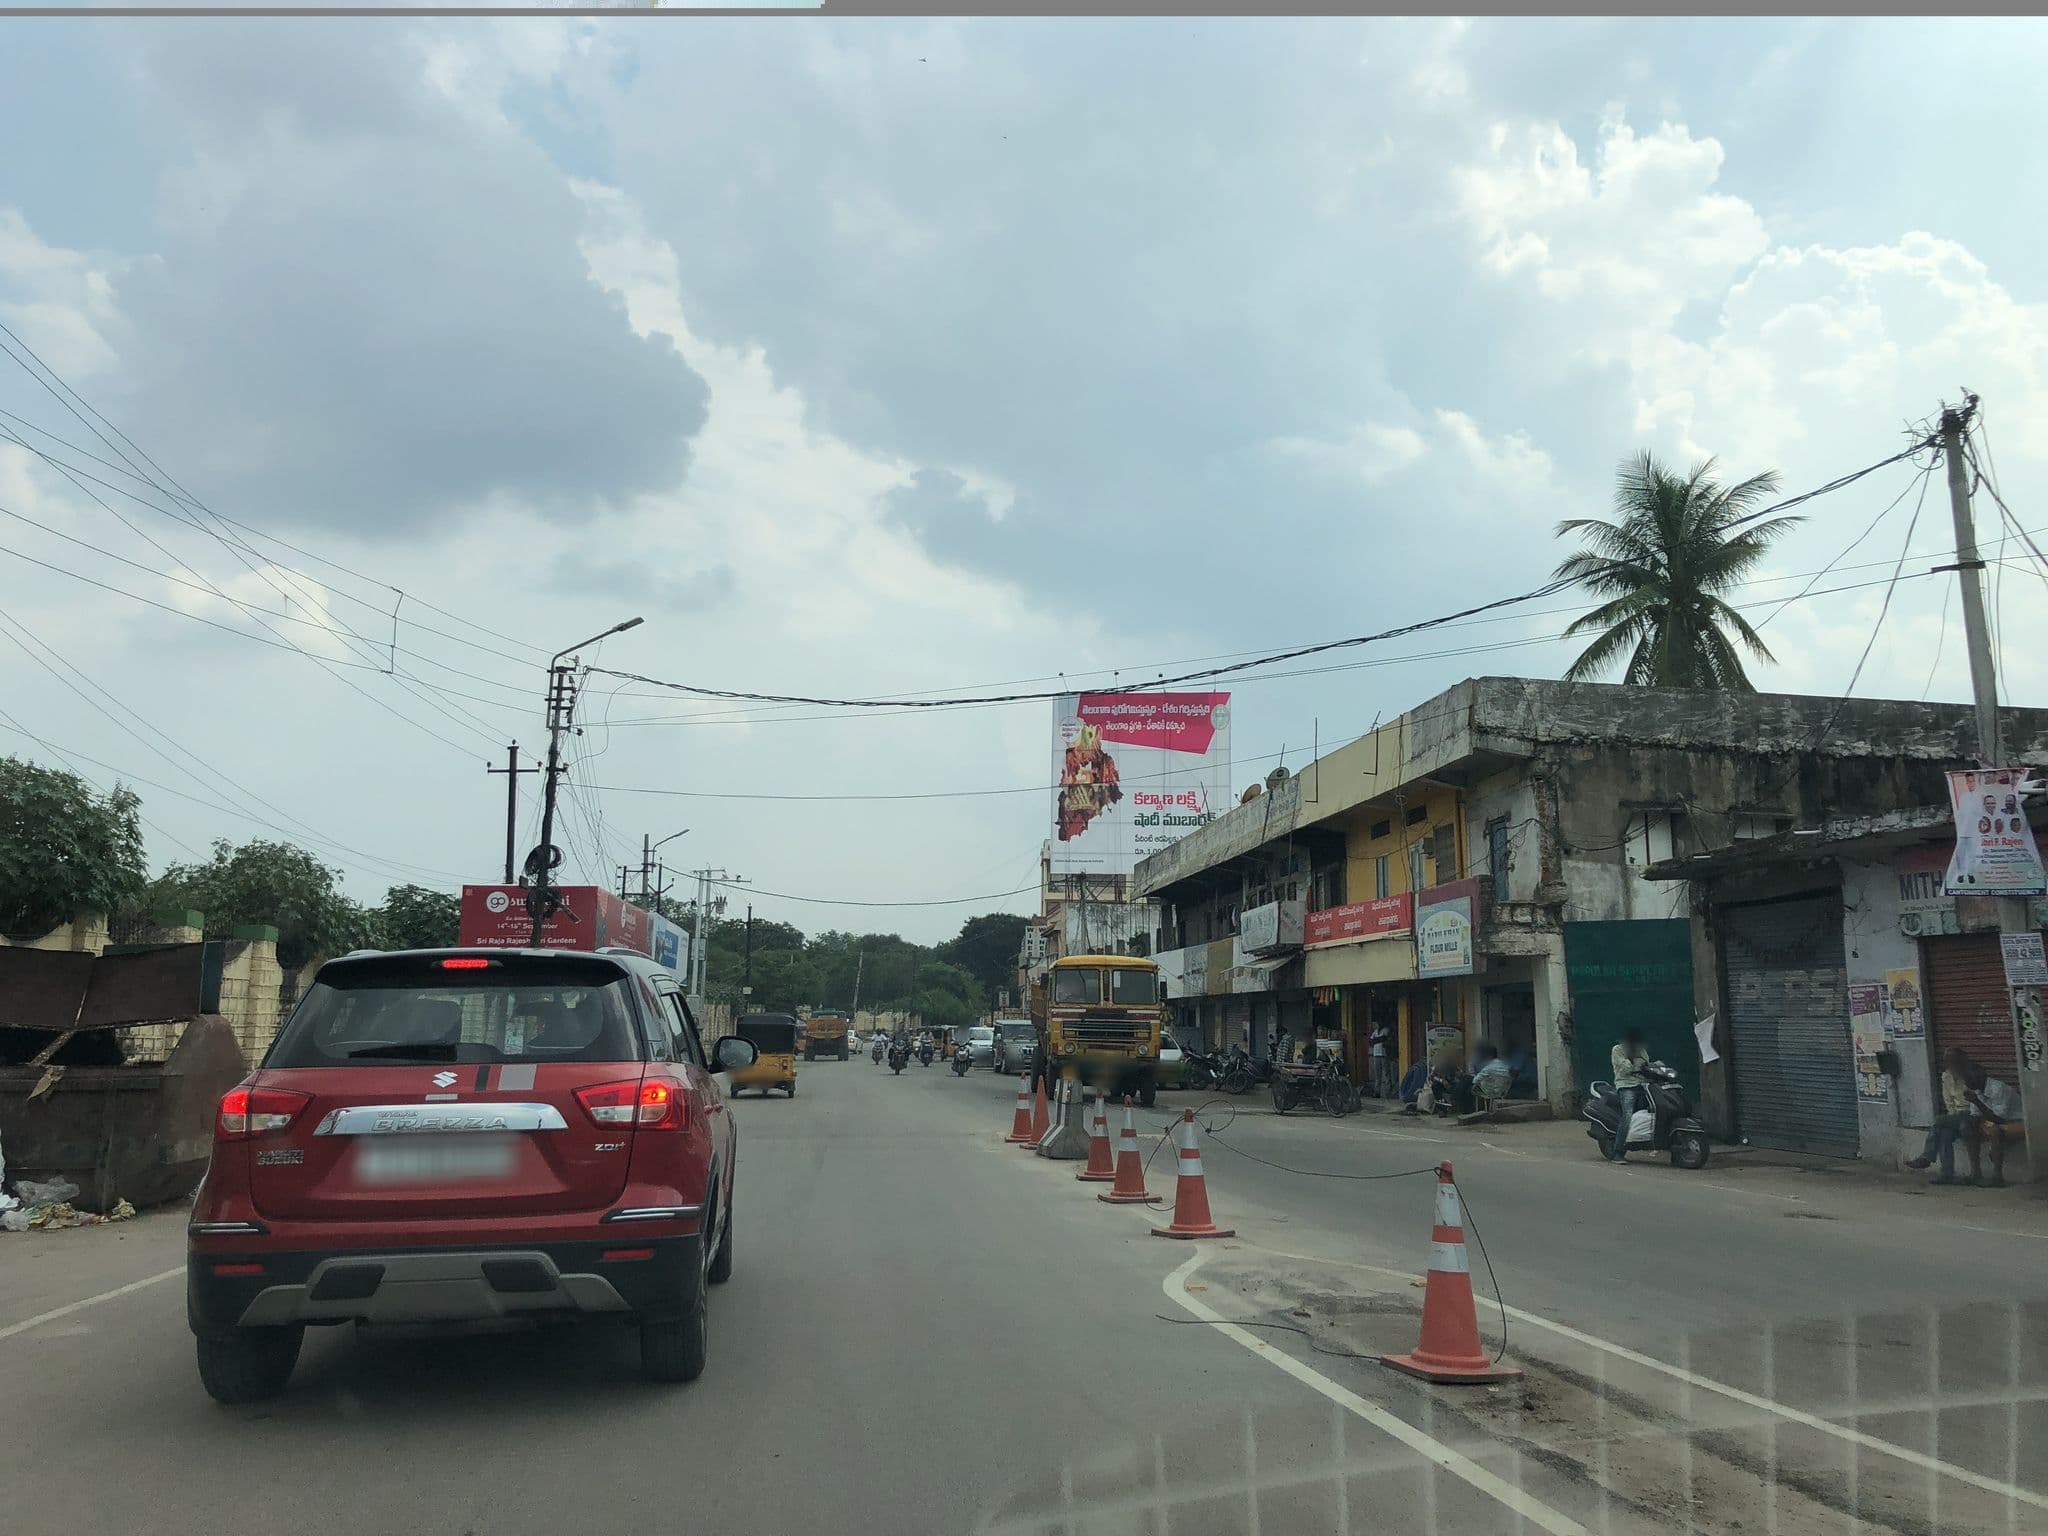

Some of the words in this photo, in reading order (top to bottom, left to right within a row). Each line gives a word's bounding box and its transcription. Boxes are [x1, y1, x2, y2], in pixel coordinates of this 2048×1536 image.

[1134, 791, 1173, 810] కల్యాణ
[1176, 790, 1202, 813] లక్ష్మి
[1134, 812, 1160, 828] షాదీ
[488, 937, 505, 945] Raja
[372, 1116, 508, 1131] BREZZA
[256, 1156, 304, 1166] SUZUKI
